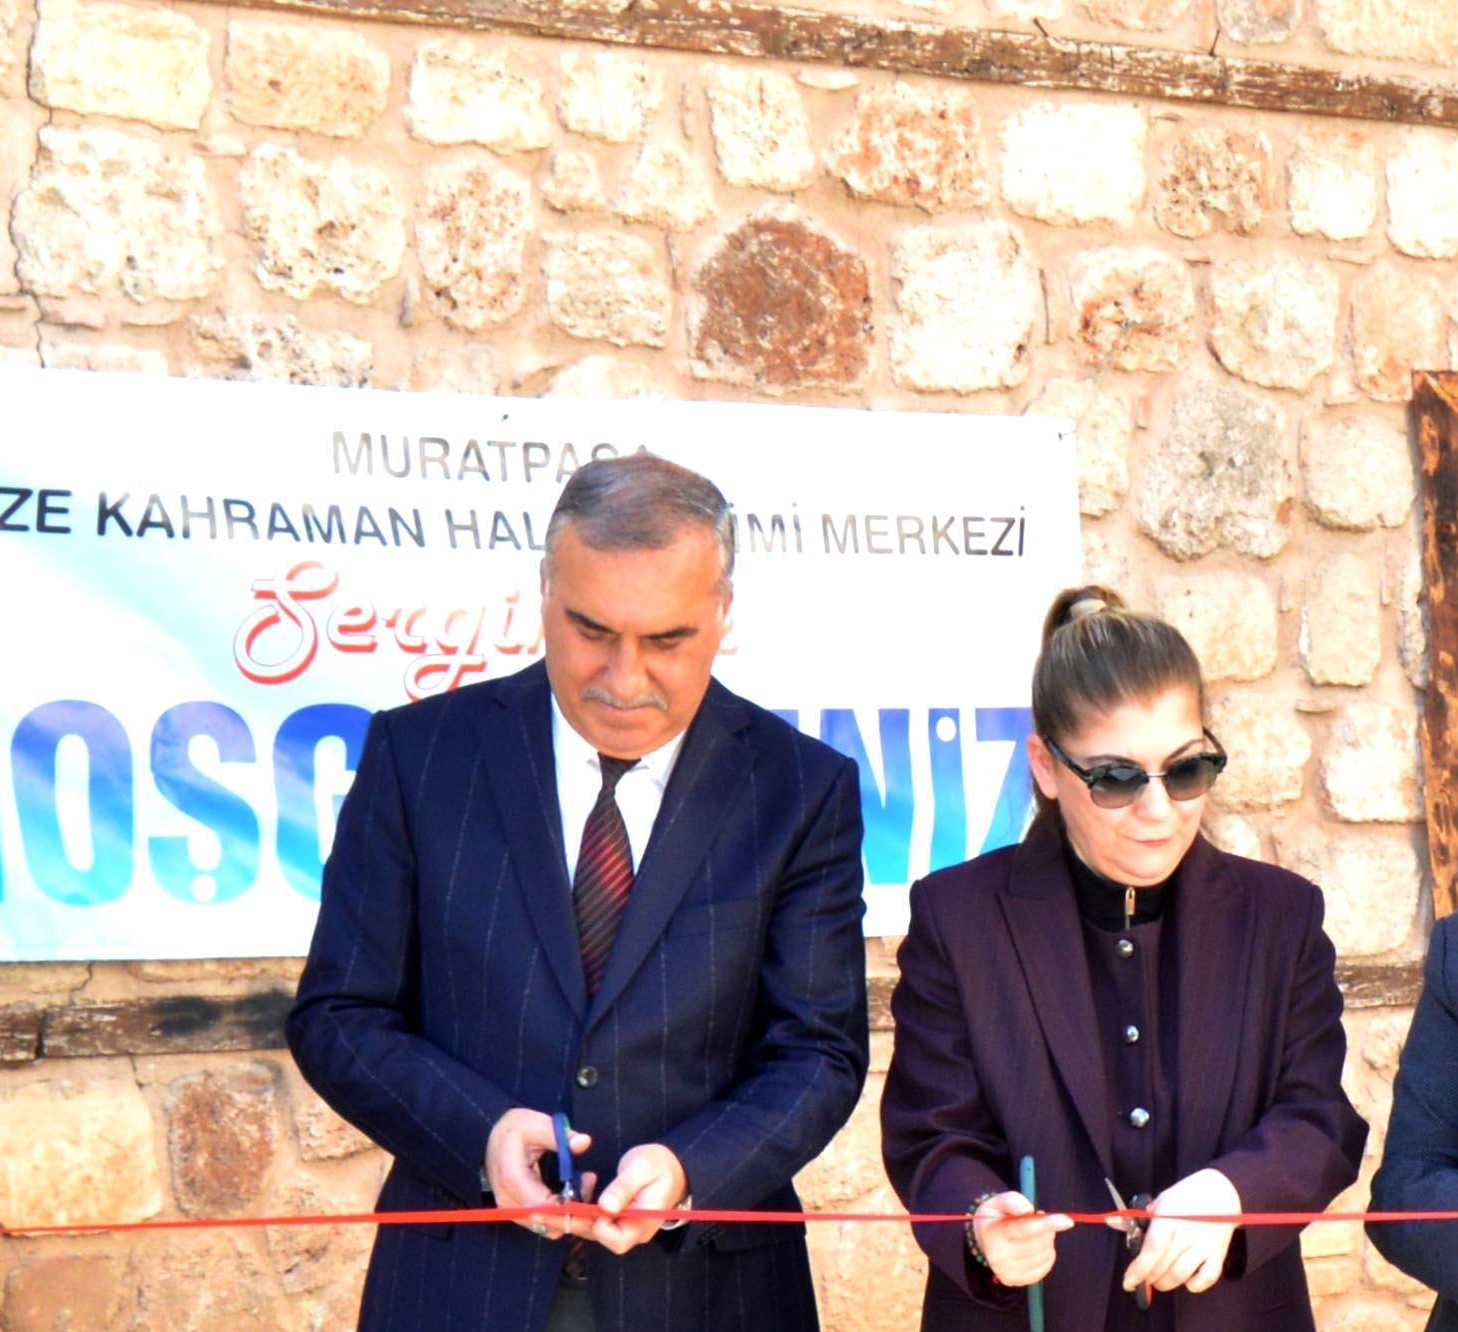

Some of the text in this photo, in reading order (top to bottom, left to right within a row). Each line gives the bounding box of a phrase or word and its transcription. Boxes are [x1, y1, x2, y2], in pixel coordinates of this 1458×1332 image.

[332, 430, 655, 484] MURATPA
[96, 491, 426, 549] KAHRAMAN
[444, 508, 547, 551] HAL
[820, 505, 1027, 557] MERKEZİ
[232, 560, 739, 703] Sergi
